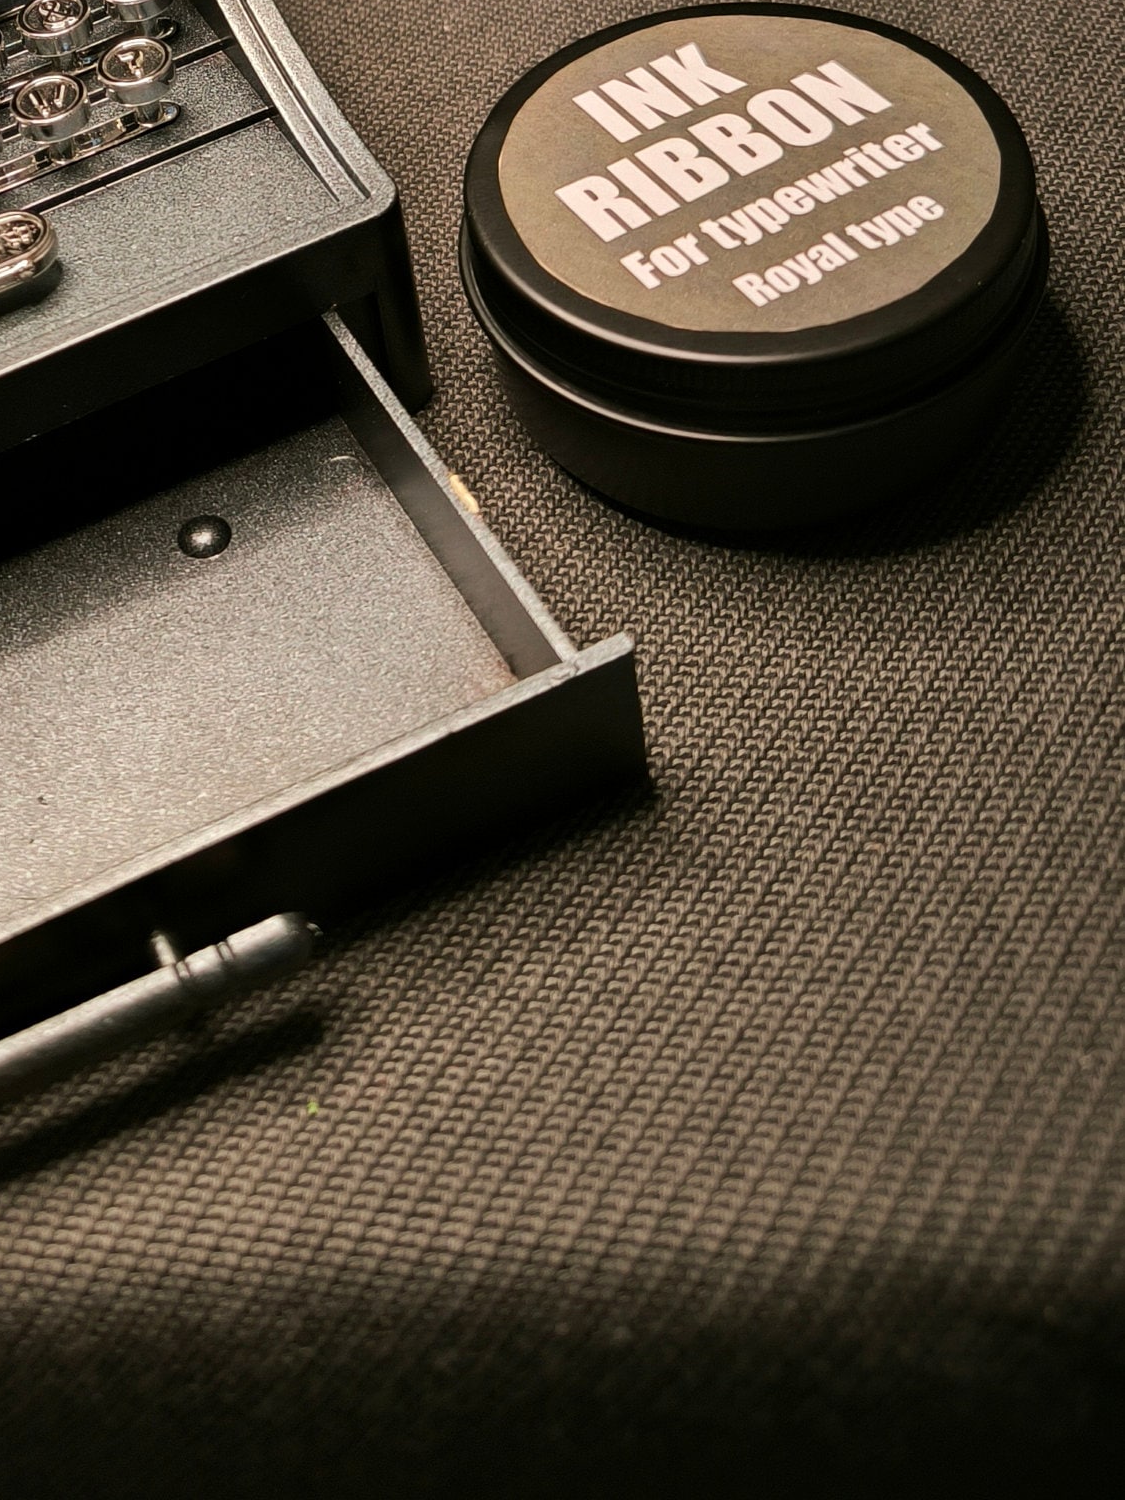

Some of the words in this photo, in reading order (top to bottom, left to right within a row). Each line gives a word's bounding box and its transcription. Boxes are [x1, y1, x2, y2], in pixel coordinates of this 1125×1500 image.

[554, 60, 893, 243] RIBBON
[572, 42, 749, 143] INK
[620, 232, 709, 290] For
[700, 121, 945, 251] typewriter
[732, 232, 858, 308] Royal
[846, 195, 945, 251] type
